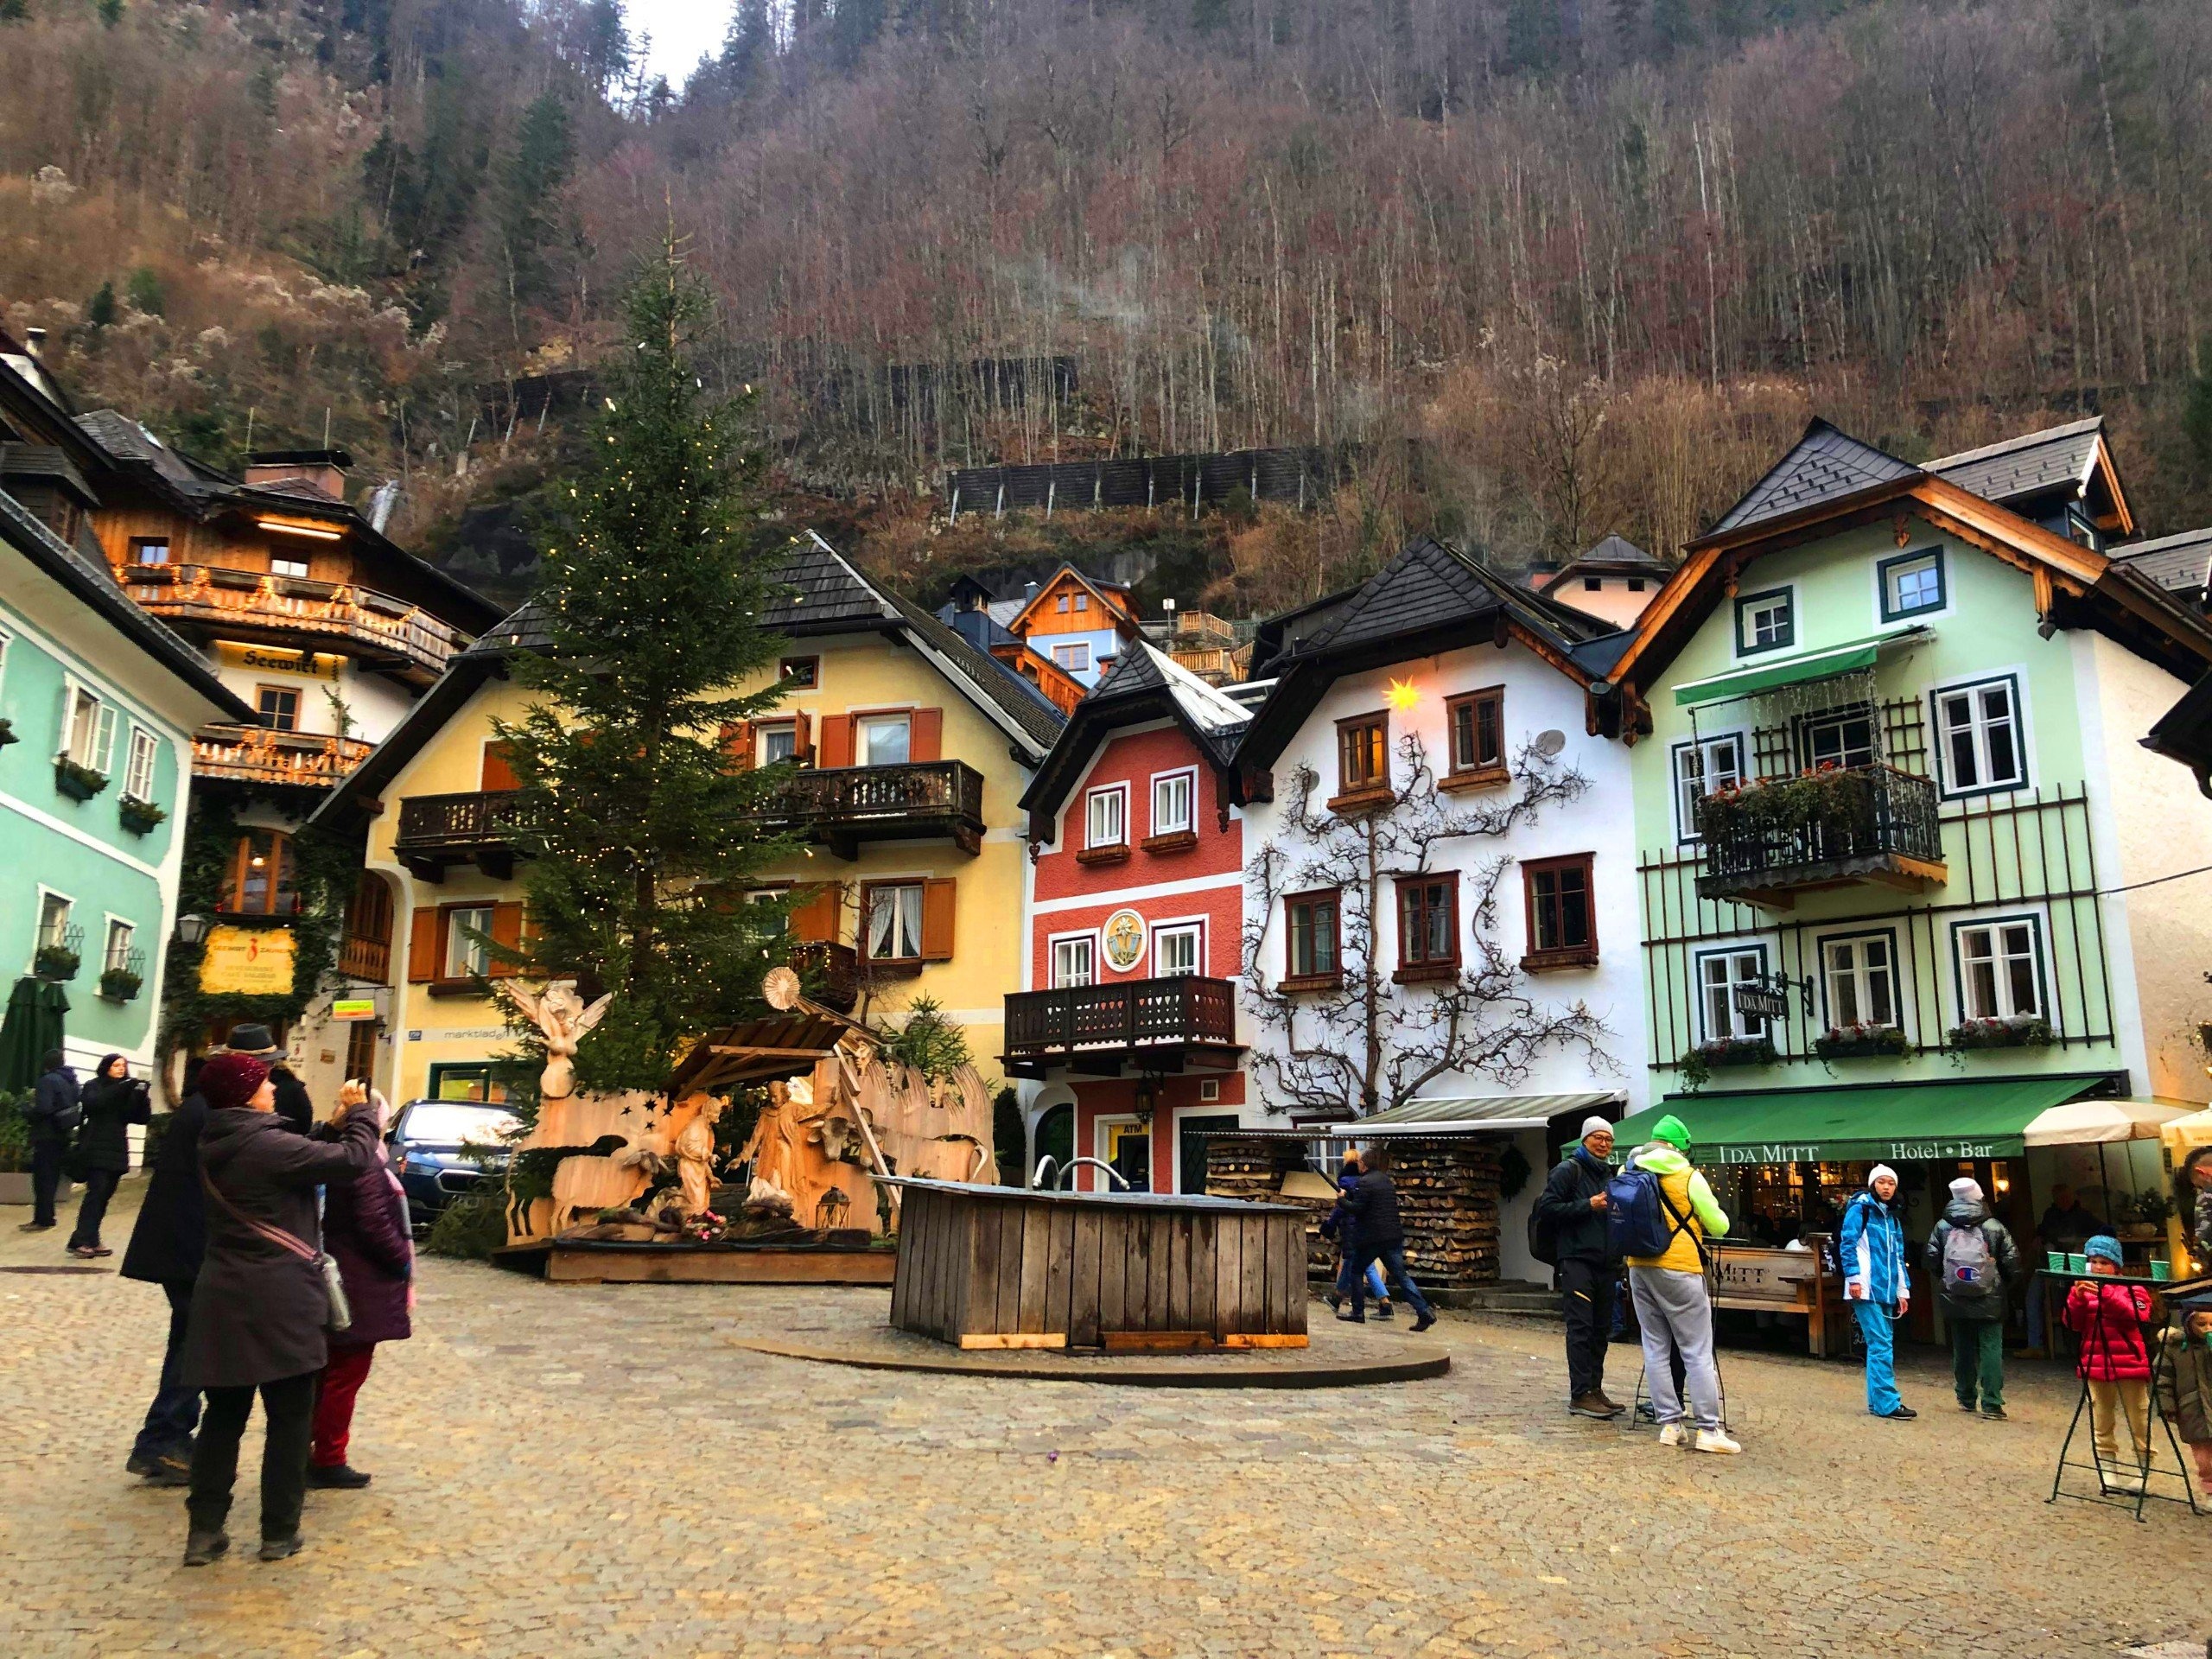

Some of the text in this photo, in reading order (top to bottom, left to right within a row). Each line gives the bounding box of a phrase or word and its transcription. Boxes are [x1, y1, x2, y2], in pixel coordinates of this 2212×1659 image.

[1737, 991, 1783, 1014] IDA MITT
[1123, 1125, 1142, 1134] ATM
[1719, 1145, 1820, 1163] IDA MITT
[1891, 1141, 1993, 1159] Hotel Bar
